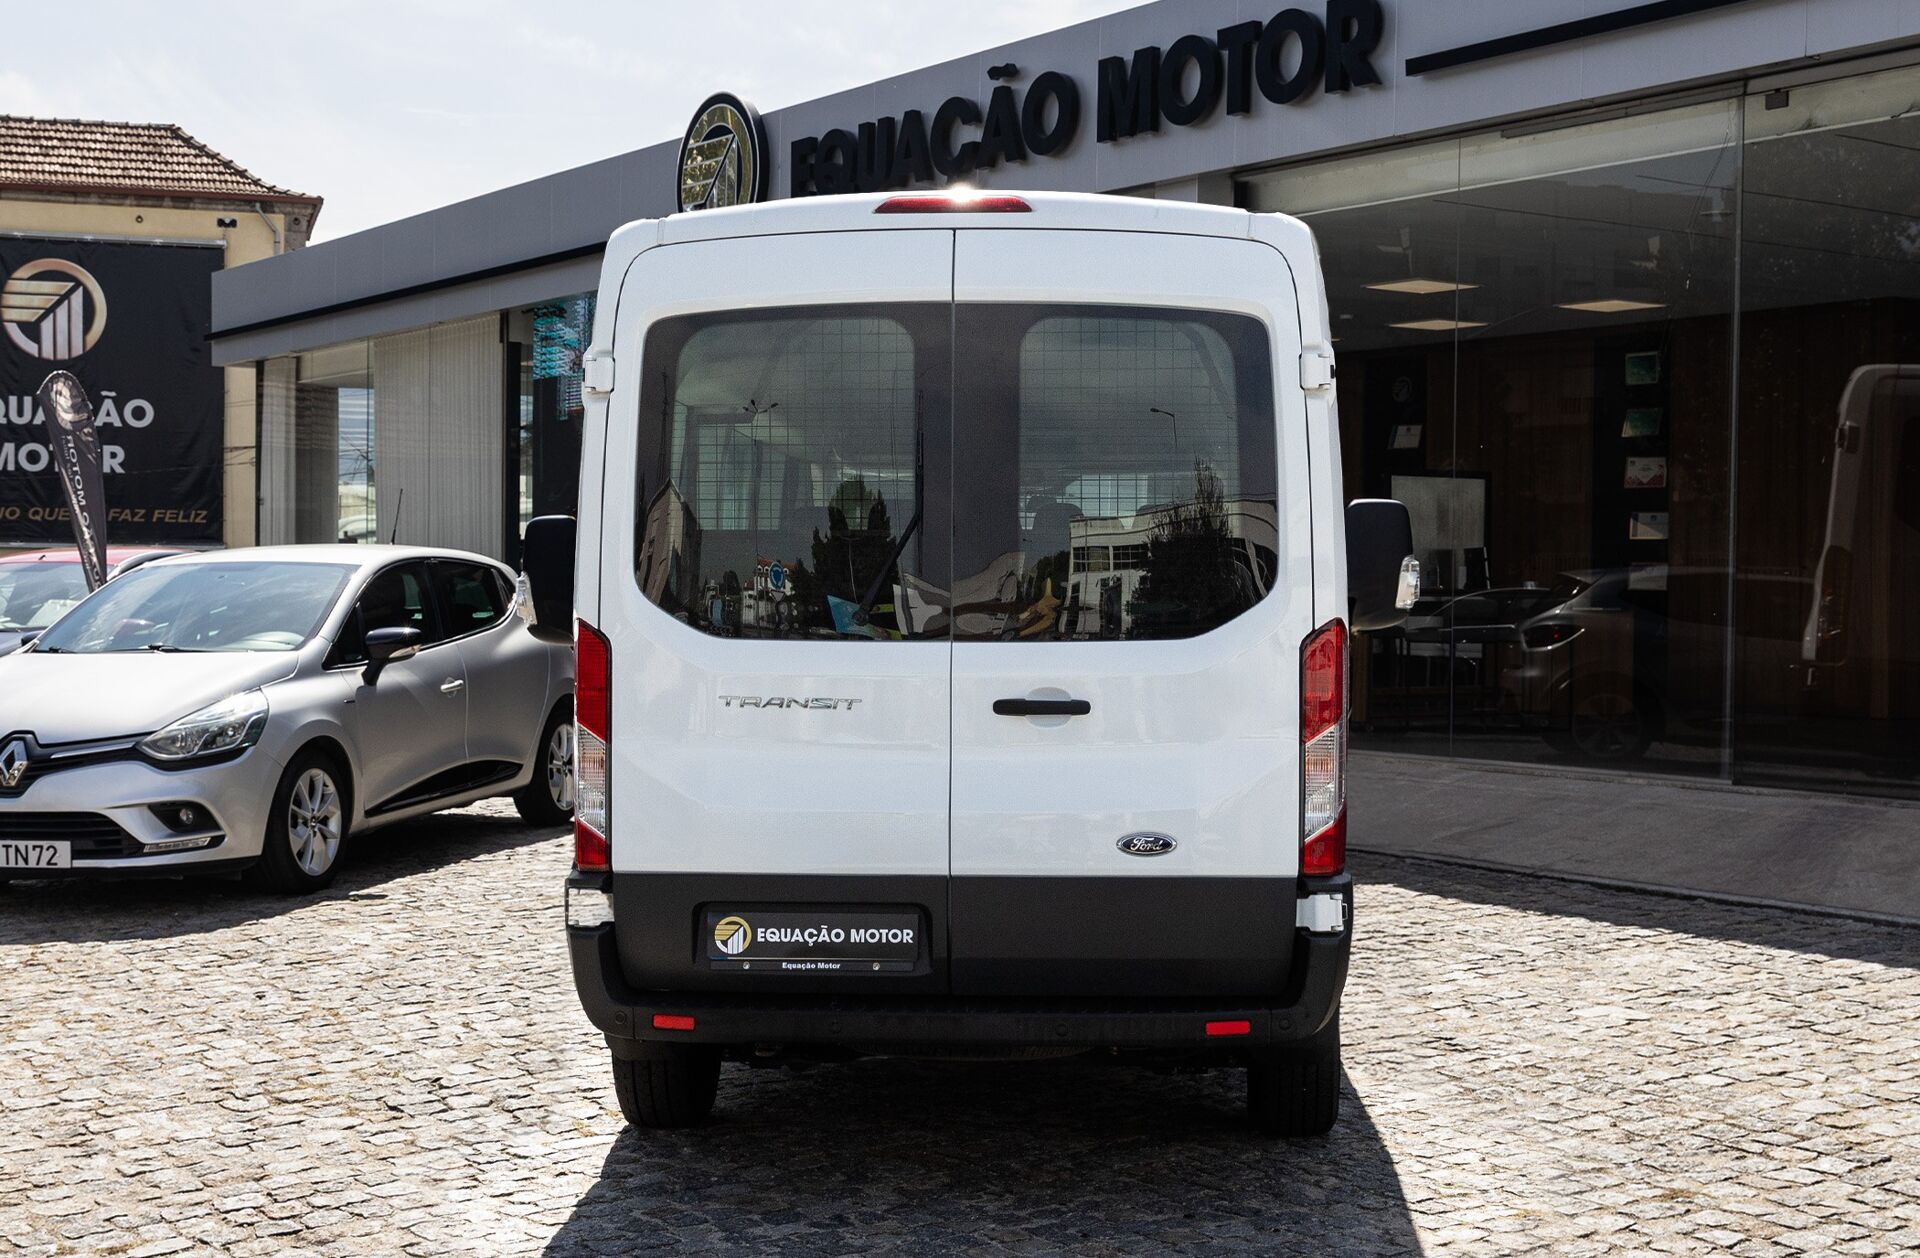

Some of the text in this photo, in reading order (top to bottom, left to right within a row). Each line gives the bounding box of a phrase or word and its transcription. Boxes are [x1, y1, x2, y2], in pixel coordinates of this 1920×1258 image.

[1097, 0, 1384, 143] MOTOR
[28, 506, 70, 521] QUE
[108, 508, 146, 522] FAZ
[152, 509, 208, 523] FELIZ
[718, 695, 862, 711] TRANSIT
[757, 925, 914, 947] EQUAÇÃO MOTOR
[782, 962, 841, 971] Equação Motor
